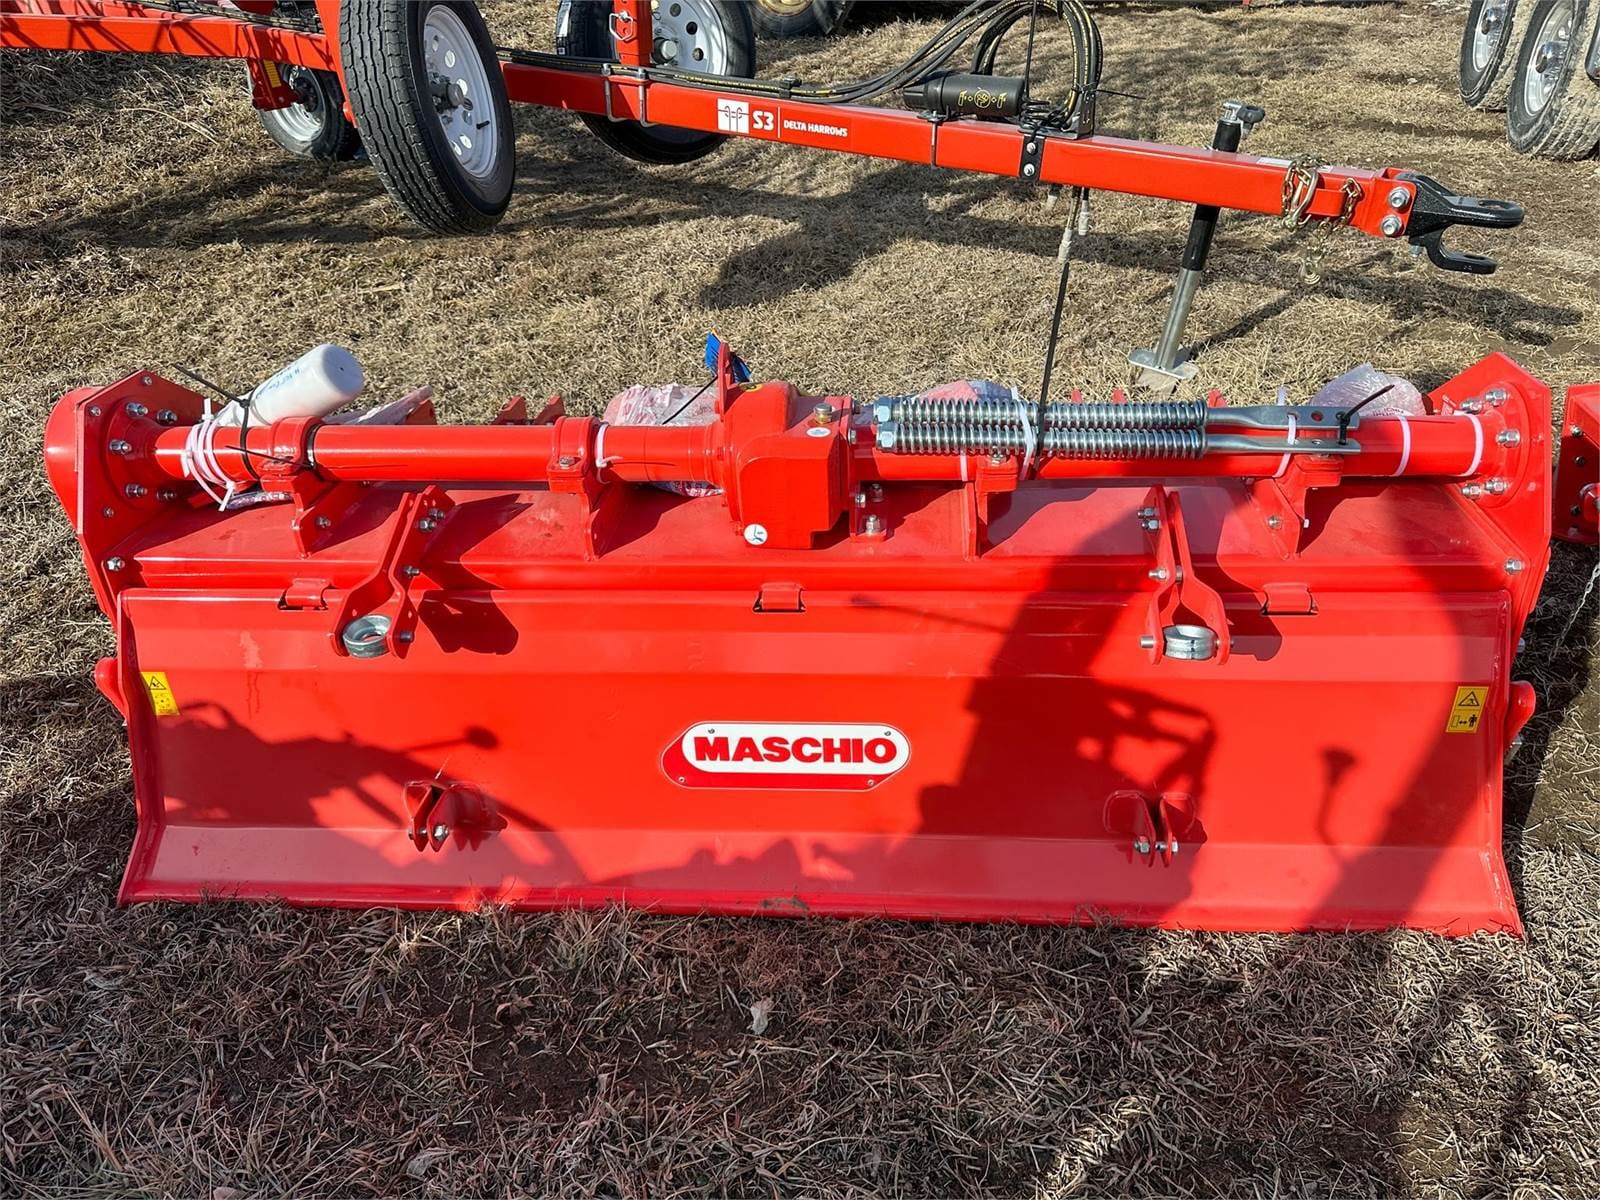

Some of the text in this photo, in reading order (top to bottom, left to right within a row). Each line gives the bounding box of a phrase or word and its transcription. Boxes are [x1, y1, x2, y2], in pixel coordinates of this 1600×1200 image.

[752, 110, 774, 130] S3
[783, 119, 848, 136] DELTA HARROWS
[693, 736, 898, 764] MASCHIO
